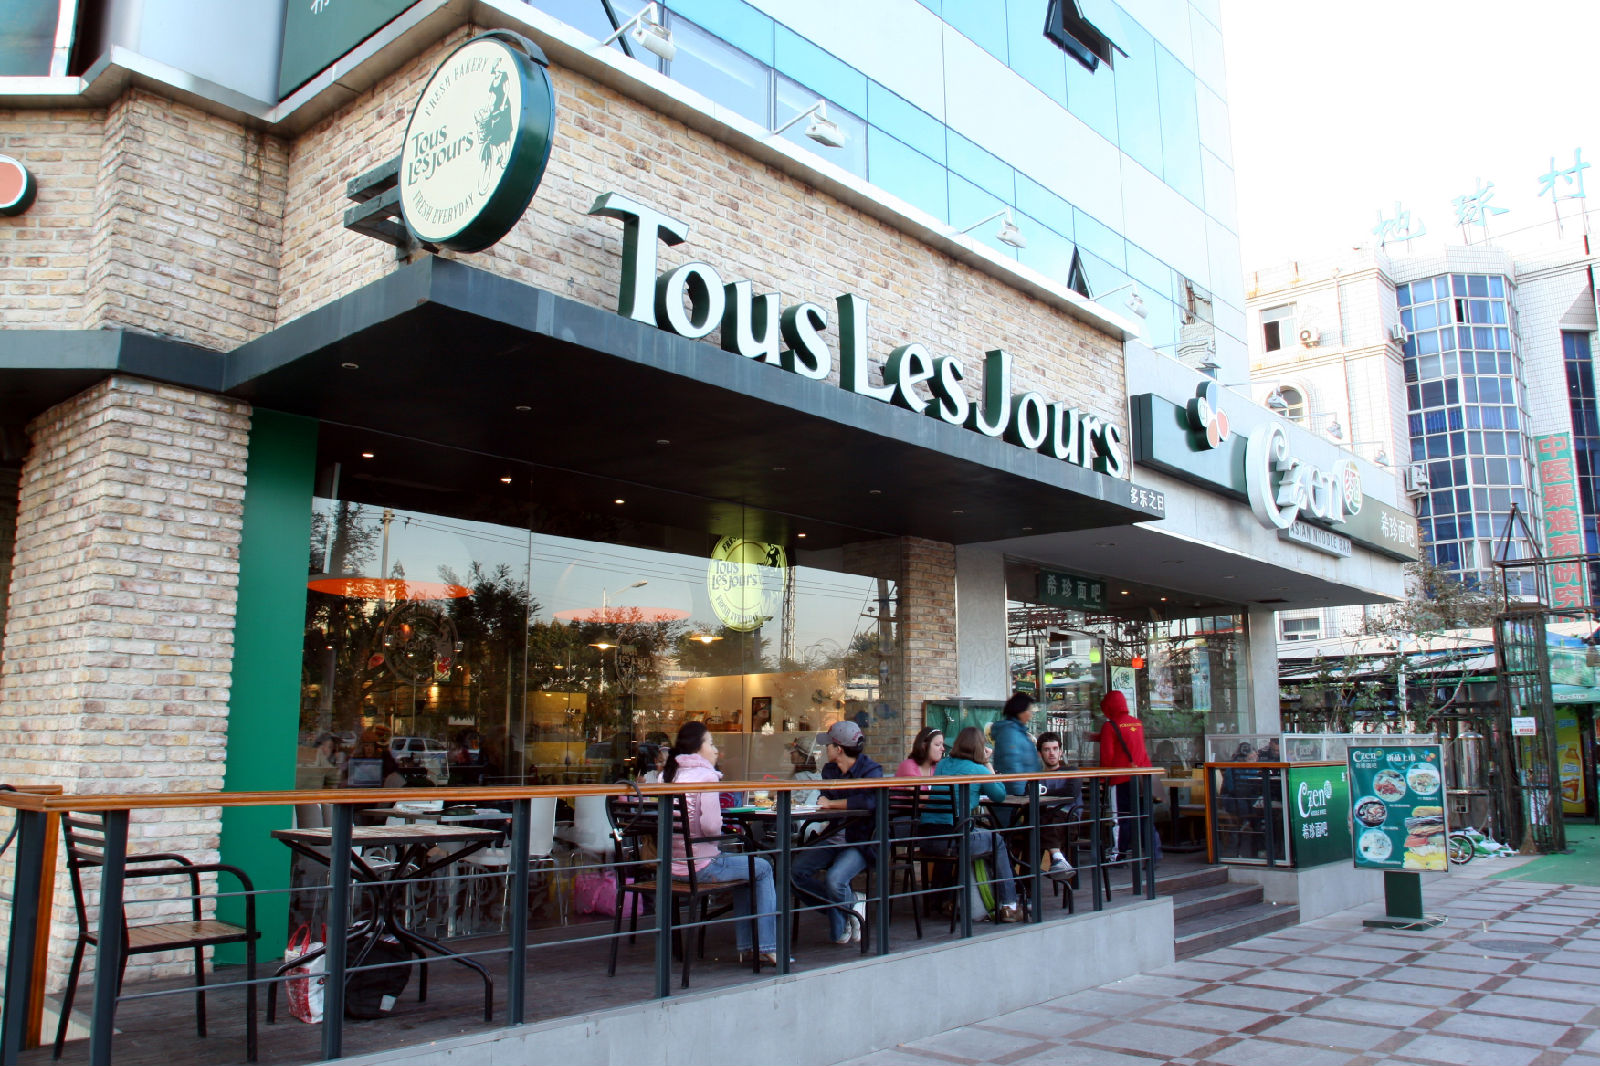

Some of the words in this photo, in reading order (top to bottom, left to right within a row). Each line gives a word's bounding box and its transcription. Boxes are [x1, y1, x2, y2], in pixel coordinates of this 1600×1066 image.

[411, 125, 448, 159] Tous
[431, 192, 474, 225] EVERYDAY
[1130, 486, 1164, 511] 多乐之日
[1289, 521, 1311, 541] ASIAN
[1312, 528, 1337, 549] NOODLE
[1380, 511, 1415, 548] 希珍面吧
[714, 559, 740, 574] Tous
[1046, 574, 1101, 603] 希珍面吧
[1297, 781, 1327, 818] Czen
[1302, 821, 1329, 839] 希珍面吧
